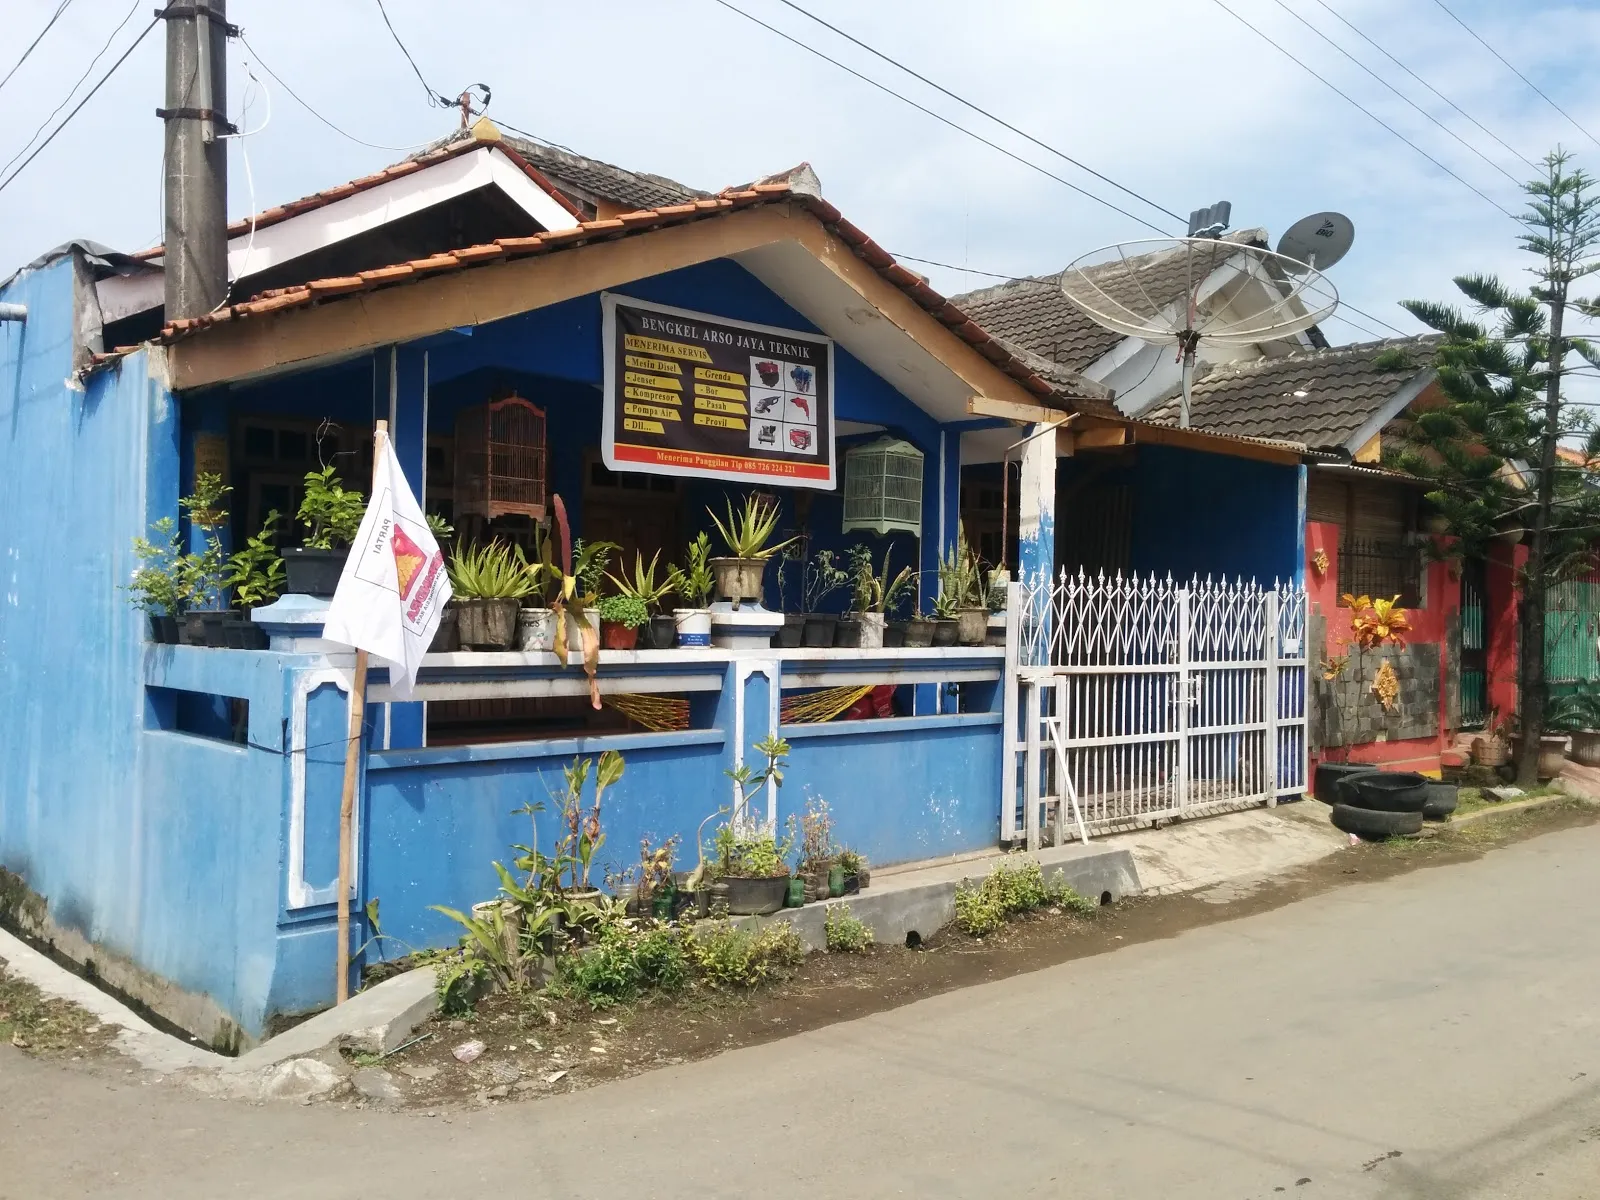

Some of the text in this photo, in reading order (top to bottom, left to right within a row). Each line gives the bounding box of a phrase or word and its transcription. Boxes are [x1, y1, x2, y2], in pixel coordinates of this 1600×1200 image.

[642, 317, 811, 359] BENGKEL ARSO JAYA TEKNIK
[625, 337, 708, 360] MENERIMA SERVIS
[631, 358, 677, 372] Mesin Disel
[632, 374, 656, 386] Jenset
[705, 370, 731, 382] Grenda
[632, 388, 675, 403] Kompresor
[705, 387, 719, 396] Bor
[632, 405, 673, 418] Pompa Air
[706, 401, 727, 411] Pasah
[705, 417, 728, 427] Provil
[657, 452, 796, 473] Menerima Panggilan Tlp 085 726 224 221
